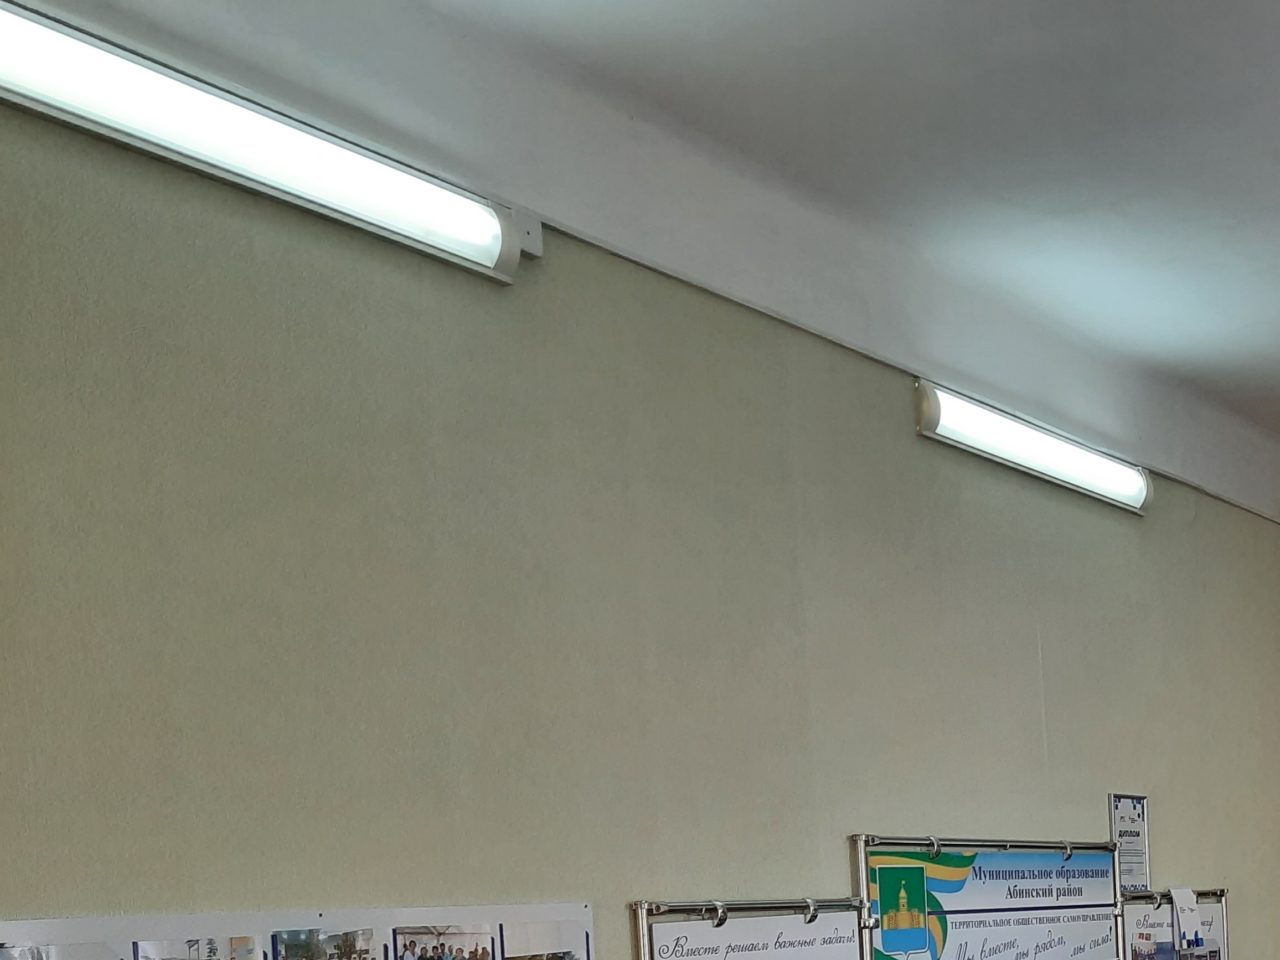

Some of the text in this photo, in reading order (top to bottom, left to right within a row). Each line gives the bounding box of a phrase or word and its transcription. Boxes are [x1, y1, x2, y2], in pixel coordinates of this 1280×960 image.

[972, 866, 1110, 884] Муниципальное образование
[1005, 884, 1083, 901] Абинский район
[1013, 916, 1062, 927] ОБЩЕСТВЕННОЕ
[1062, 913, 1113, 924] САМОУПРАВЛЕНИЕ
[658, 935, 720, 960] Вместе
[723, 940, 769, 960] решаем
[774, 931, 817, 949] важные
[980, 937, 1020, 960] вместе,
[1070, 925, 1113, 958] мы сила!
